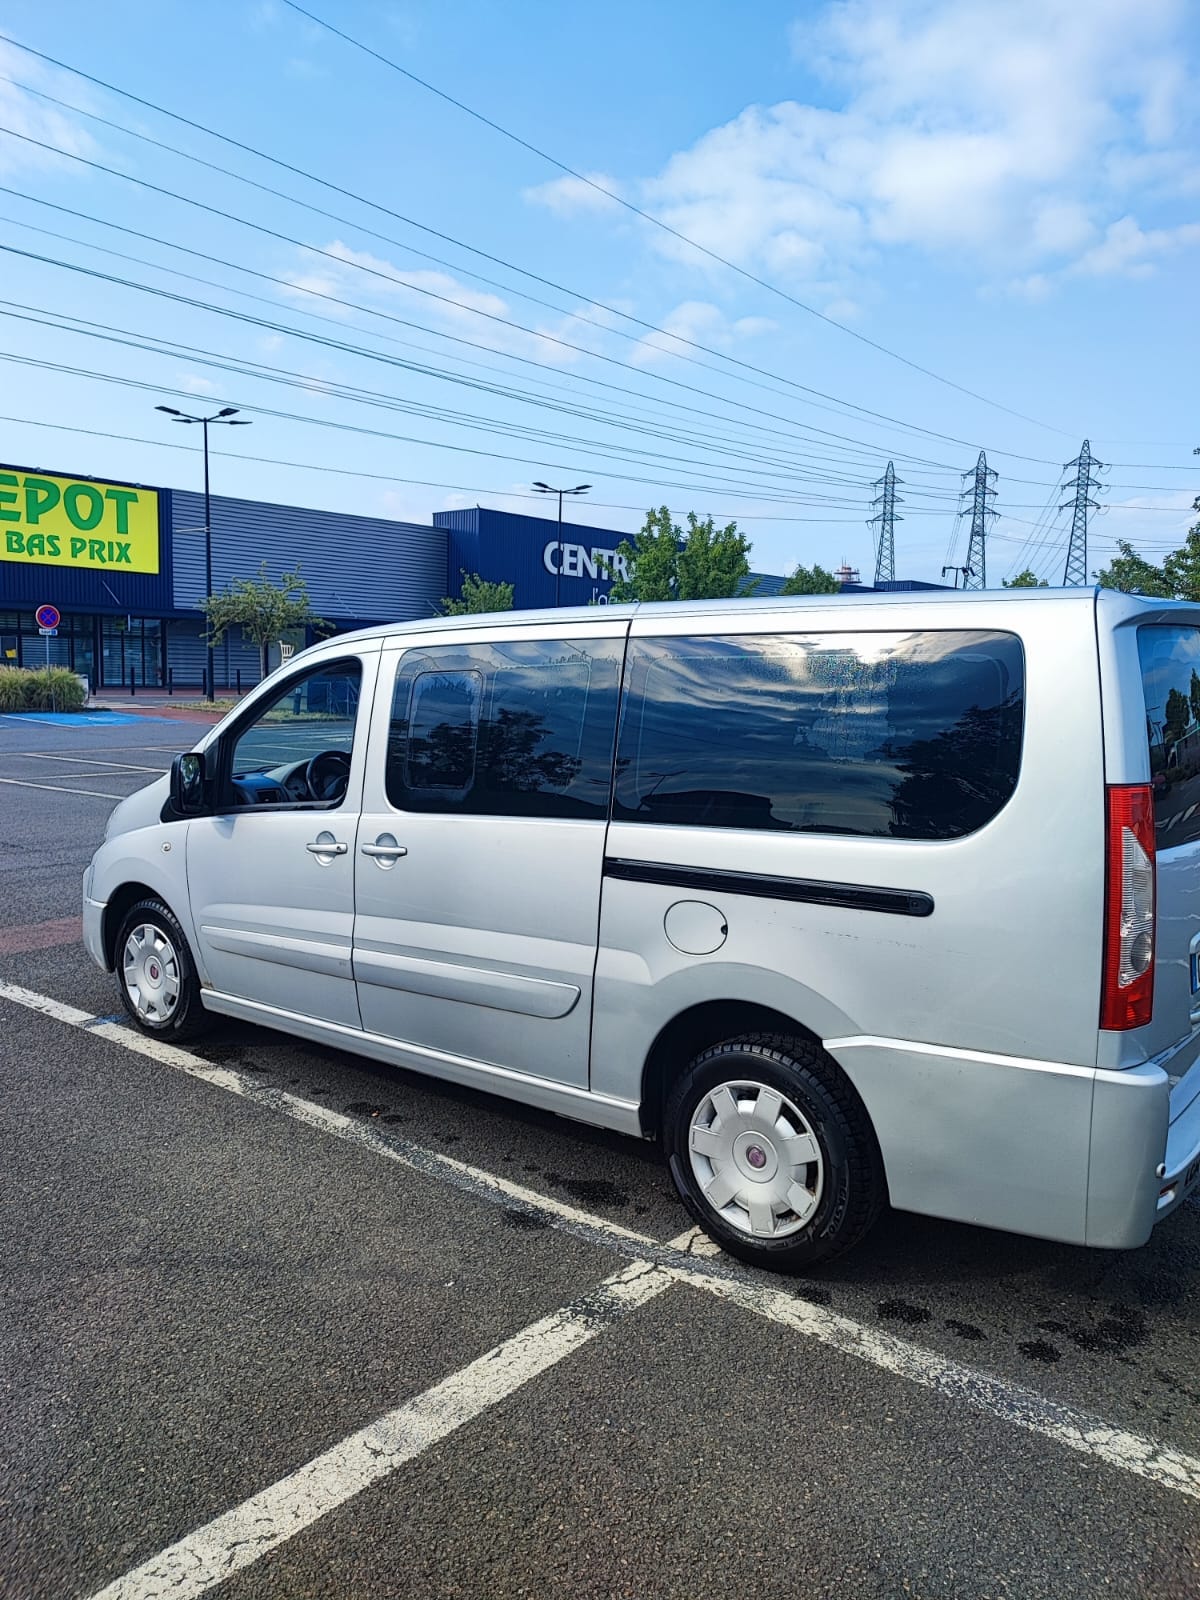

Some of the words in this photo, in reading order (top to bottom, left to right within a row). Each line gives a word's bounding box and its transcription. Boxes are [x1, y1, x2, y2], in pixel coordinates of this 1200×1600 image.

[5, 530, 61, 557] BAS
[70, 537, 132, 564] PRIX
[543, 540, 636, 583] CENTR
